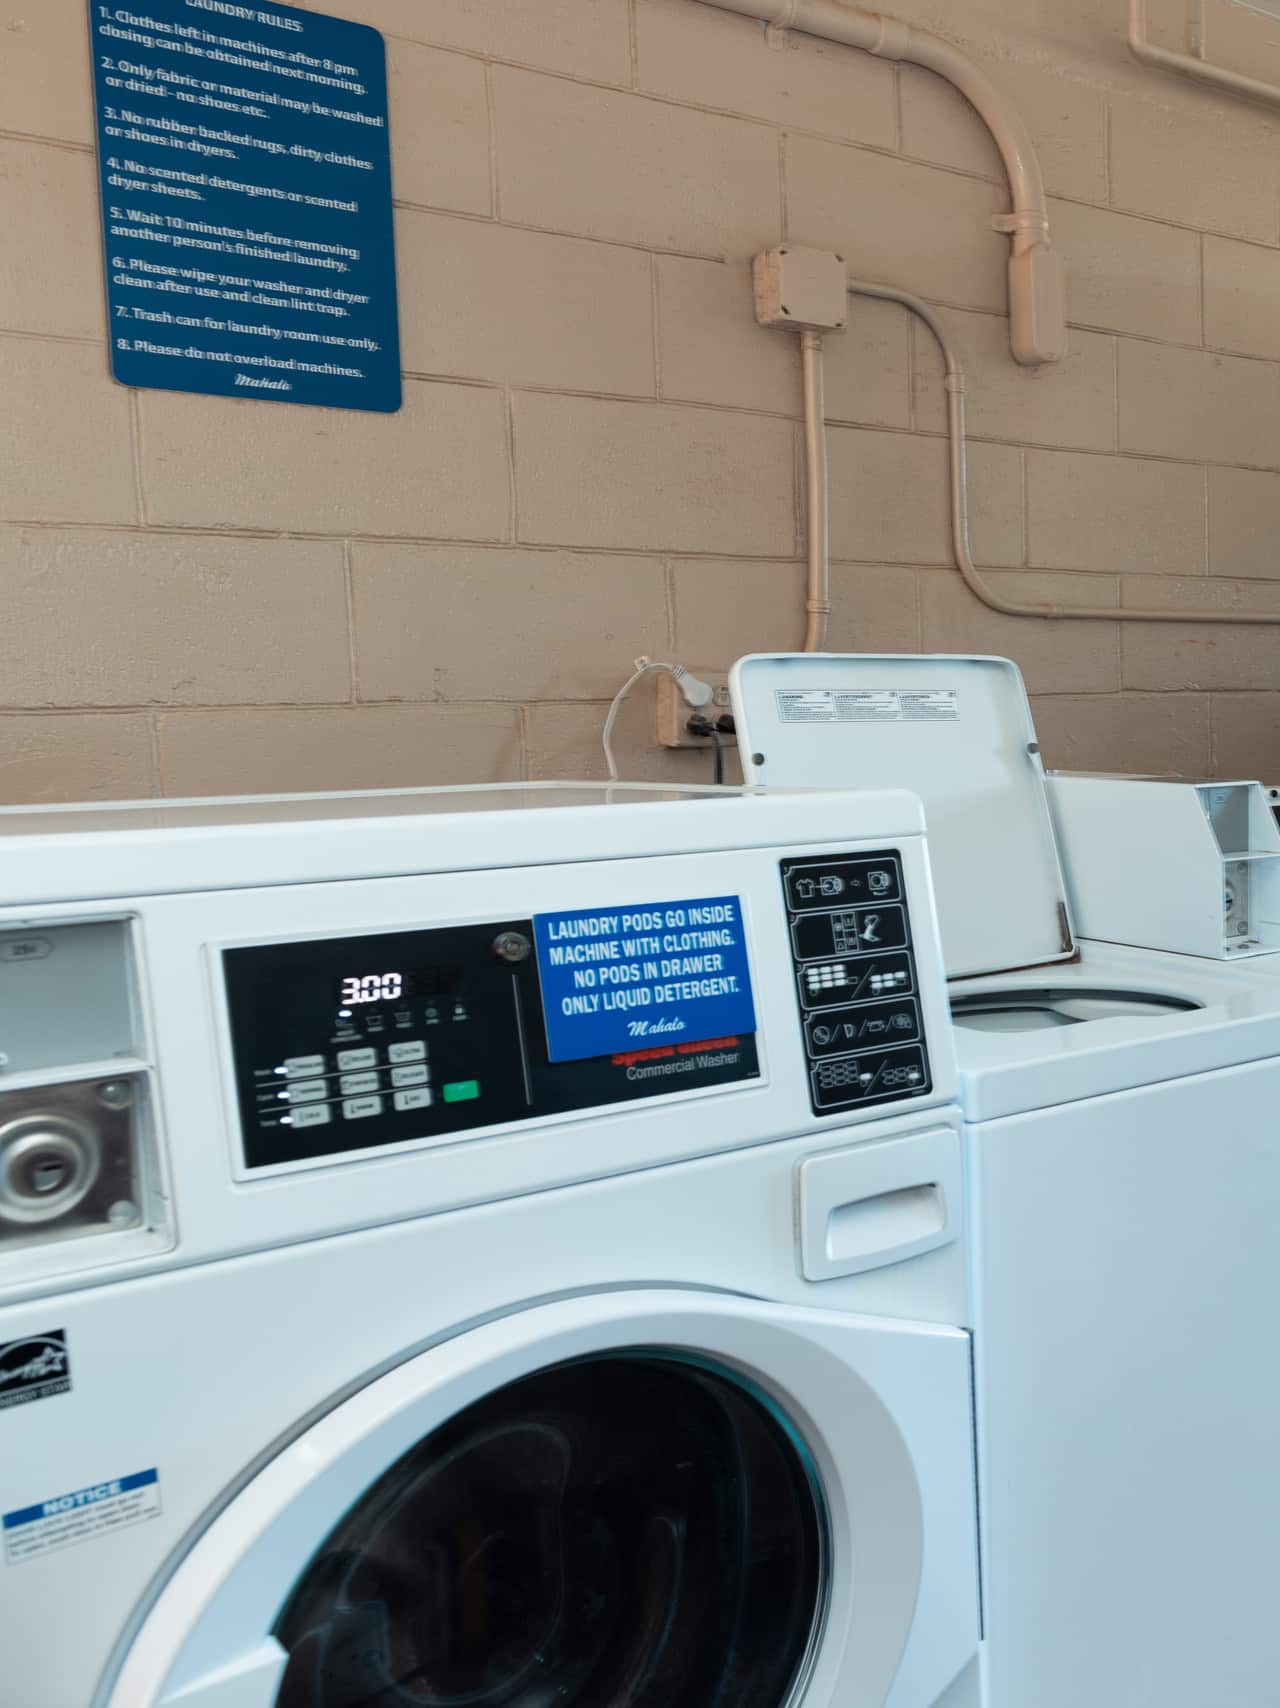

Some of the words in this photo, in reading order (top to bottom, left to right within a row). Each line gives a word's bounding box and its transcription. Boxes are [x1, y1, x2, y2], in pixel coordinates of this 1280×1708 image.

[99, 6, 115, 20] 1.
[115, 10, 172, 33] Clothes
[174, 23, 200, 39] left
[202, 30, 219, 43] in
[219, 37, 288, 60] machines
[288, 51, 321, 68] after
[257, 11, 303, 32] RULES
[99, 24, 155, 48] closing
[156, 39, 184, 52] can
[184, 42, 206, 57] be
[206, 50, 272, 72] obtained
[272, 64, 305, 80] next
[306, 72, 368, 95] morning.
[101, 56, 118, 70] 2.
[118, 60, 156, 80] Only
[157, 67, 200, 88] fabric
[201, 80, 218, 92] or
[219, 84, 280, 105] material
[281, 98, 312, 114] may
[312, 102, 332, 116] be
[332, 108, 384, 127] washed
[105, 76, 125, 88] or
[125, 78, 168, 97] dried
[176, 91, 198, 103] no
[198, 95, 241, 111] shoes
[241, 104, 271, 119] etc.
[104, 106, 121, 120] 3.
[121, 110, 145, 125] No
[145, 117, 198, 136] rubber
[199, 125, 252, 146] backed
[253, 139, 290, 154] rugs,
[290, 144, 324, 162] dirty
[324, 151, 374, 170] clothes
[105, 126, 123, 137] or
[124, 128, 170, 146] shoes
[170, 136, 188, 150] in
[188, 140, 240, 159] dryers.
[106, 157, 124, 170] 4.
[124, 160, 148, 174] No
[149, 167, 209, 185] scented
[209, 176, 288, 198] detergents
[288, 191, 304, 203] or
[304, 194, 359, 212] scented
[108, 174, 150, 191] dryer
[151, 182, 206, 201] sheets.
[110, 206, 127, 219] 5.
[127, 209, 163, 226] Wait
[165, 216, 186, 229] 10
[186, 221, 246, 239] minutes
[246, 229, 294, 247] before
[294, 240, 360, 260] removing
[111, 225, 171, 243] another
[235, 243, 294, 263] finished
[294, 252, 351, 272] laundry.
[112, 256, 129, 270] 6.
[129, 258, 180, 277] Please
[180, 268, 217, 283] wipe
[218, 275, 252, 287] your
[253, 281, 305, 295] washer
[305, 288, 333, 299] and
[333, 289, 369, 304] dryer
[113, 273, 156, 290] clean
[156, 280, 194, 295] after
[194, 286, 221, 299] use
[222, 291, 251, 303] and
[251, 293, 291, 309] clean
[291, 298, 317, 312] lint
[316, 303, 351, 318] trap.
[115, 305, 132, 319] 7.
[132, 307, 175, 324] Trash
[175, 315, 204, 328] can
[203, 317, 227, 331] for
[227, 320, 282, 340] laundry
[282, 330, 323, 343] room
[322, 335, 347, 346] use
[346, 338, 382, 352] only.
[117, 338, 134, 351] 8.
[134, 340, 184, 357] Please
[184, 347, 206, 360] do
[207, 350, 233, 363] not
[233, 355, 297, 370] overload
[297, 362, 366, 378] machines.
[234, 373, 292, 391] Mahalo
[548, 916, 618, 940] LAUNDRY
[622, 911, 662, 932] PODS
[665, 909, 686, 928] GO
[688, 904, 735, 926] INSIDE
[549, 941, 621, 966] MACHINE
[621, 936, 660, 957] WITH
[663, 929, 736, 952] CLOTHING.
[574, 969, 595, 989] NO
[598, 963, 641, 985] PODS
[643, 961, 658, 980] IN
[661, 953, 723, 977] DRAWER
[562, 994, 600, 1016] ONLY
[602, 987, 651, 1011] LIQUID
[654, 976, 740, 1003] DETERGENT.
[627, 1017, 687, 1037] Mahalo
[626, 1058, 695, 1081] Commercial
[696, 1051, 741, 1069] Washer
[43, 1480, 122, 1517] NOTICE
